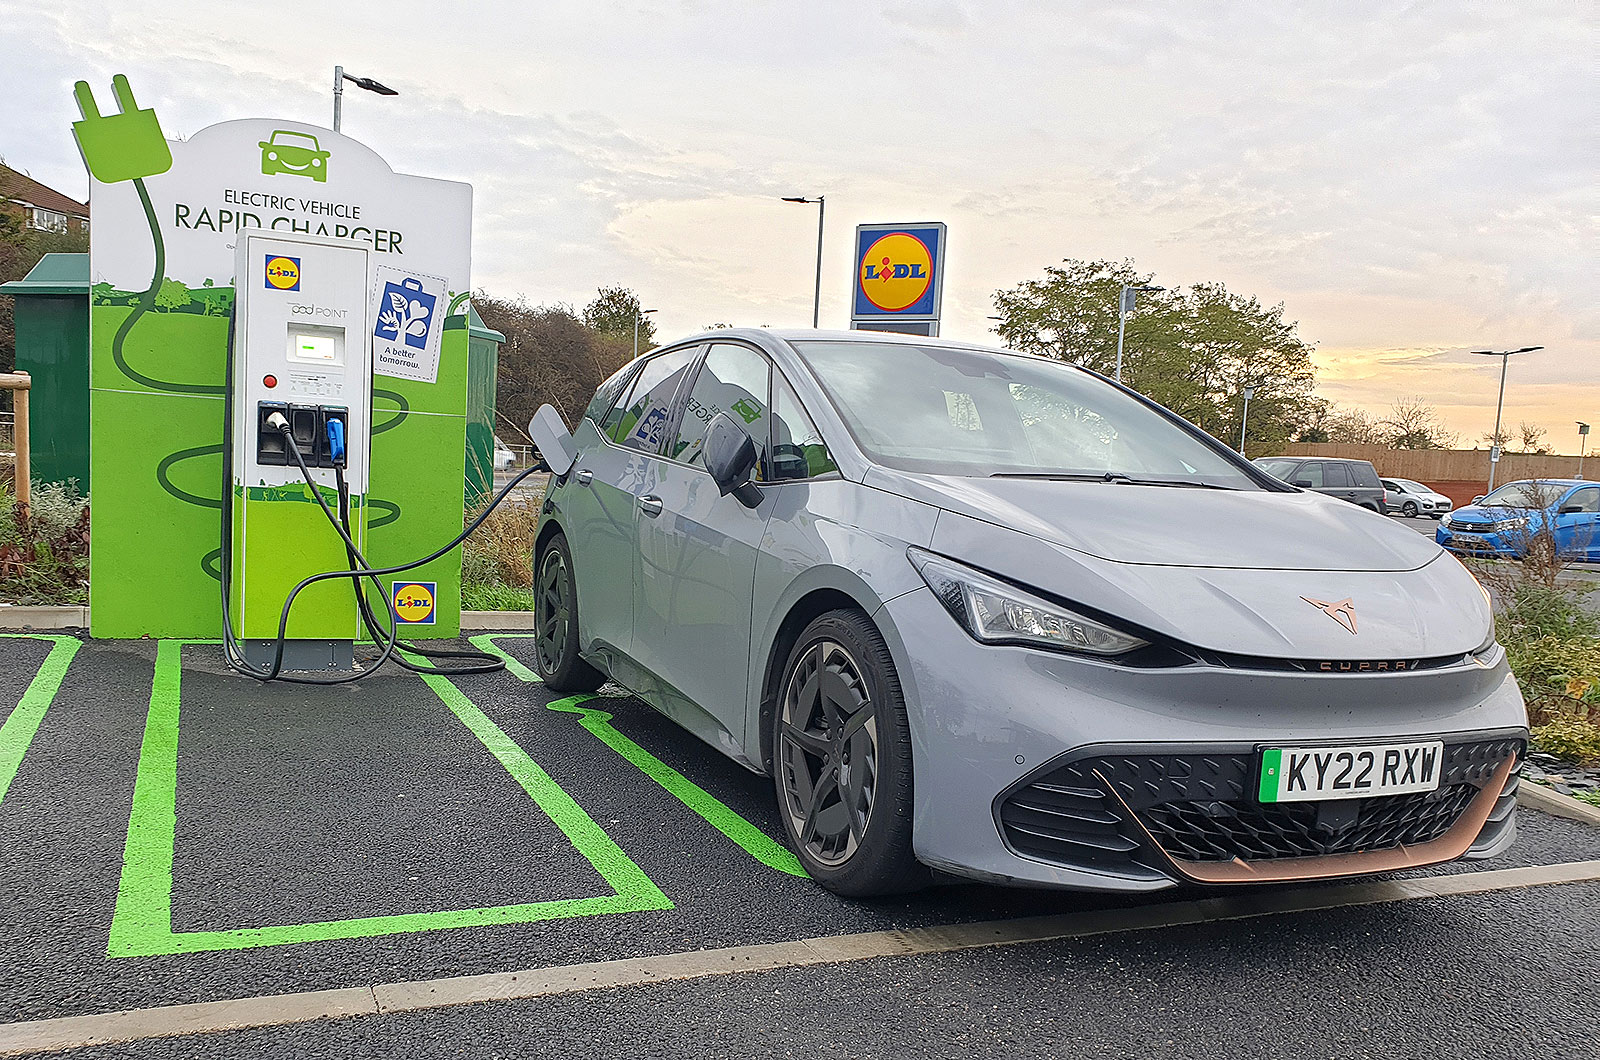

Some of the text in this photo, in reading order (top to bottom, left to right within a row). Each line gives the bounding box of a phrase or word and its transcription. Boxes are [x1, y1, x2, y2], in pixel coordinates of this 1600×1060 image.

[224, 189, 361, 220] ELECTRIC VEHICLE
[175, 203, 262, 235] RAPID
[315, 307, 349, 318] POINT
[384, 346, 416, 359] A better
[379, 354, 420, 369] tomorrow.
[1319, 661, 1407, 671] CUPRA
[1286, 746, 1438, 793] KY22 RXW
